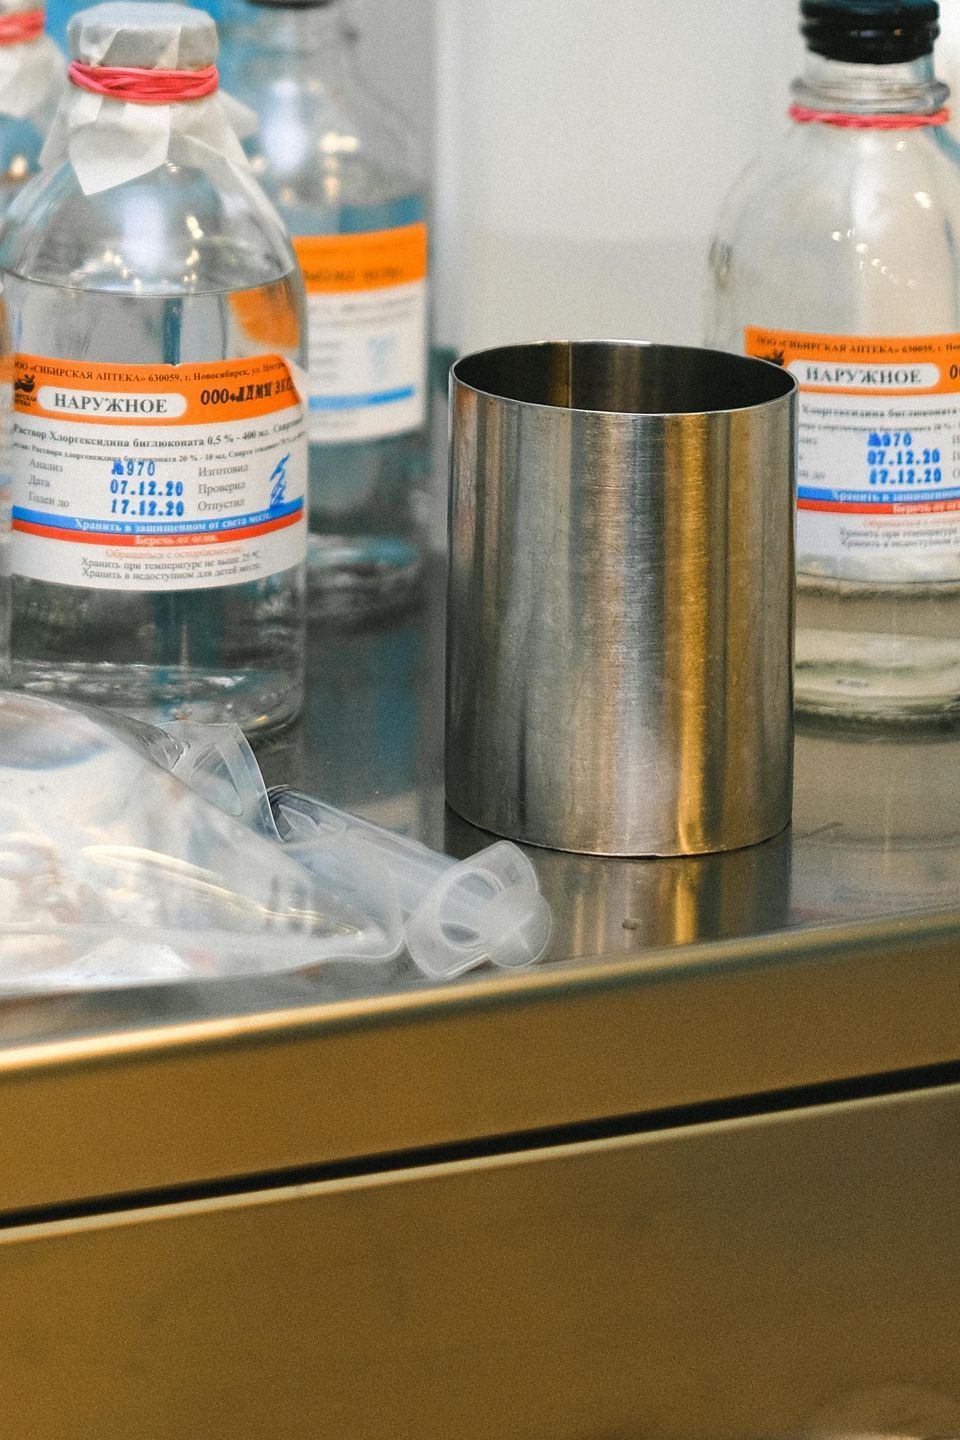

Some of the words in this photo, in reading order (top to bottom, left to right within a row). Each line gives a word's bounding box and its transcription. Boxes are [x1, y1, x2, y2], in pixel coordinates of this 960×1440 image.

[30, 363, 93, 379] «СИБИРСКАЯ
[95, 373, 146, 382] АПТЕКА»
[148, 373, 182, 382] 630059,
[193, 369, 250, 381] Новосибирск,
[806, 366, 922, 385] НАРУЖНОЕ
[54, 392, 167, 413] НАРУЖНОЕ
[13, 423, 47, 441] Раствор
[49, 431, 130, 448] Хлоргексидина
[132, 437, 205, 448] биглюконата
[223, 434, 234, 443] %
[866, 448, 941, 466] 07.12.20
[28, 458, 64, 473] Анализ
[198, 464, 249, 478] Изготовил
[27, 474, 51, 488] Дата
[110, 479, 184, 496] 07.12.20
[198, 481, 246, 496] Проверил
[28, 491, 55, 505] Годен
[58, 499, 70, 508] до
[110, 498, 185, 517] 17.12.20
[197, 498, 246, 513] Отпустил
[75, 518, 123, 533] Хранить
[208, 522, 220, 530] от
[221, 518, 247, 528] света
[81, 556, 121, 570] Хранить
[124, 561, 141, 571] при
[144, 560, 202, 571] температуре
[82, 567, 122, 580] Хранить
[133, 571, 195, 582] недоступном
[197, 570, 212, 578] для
